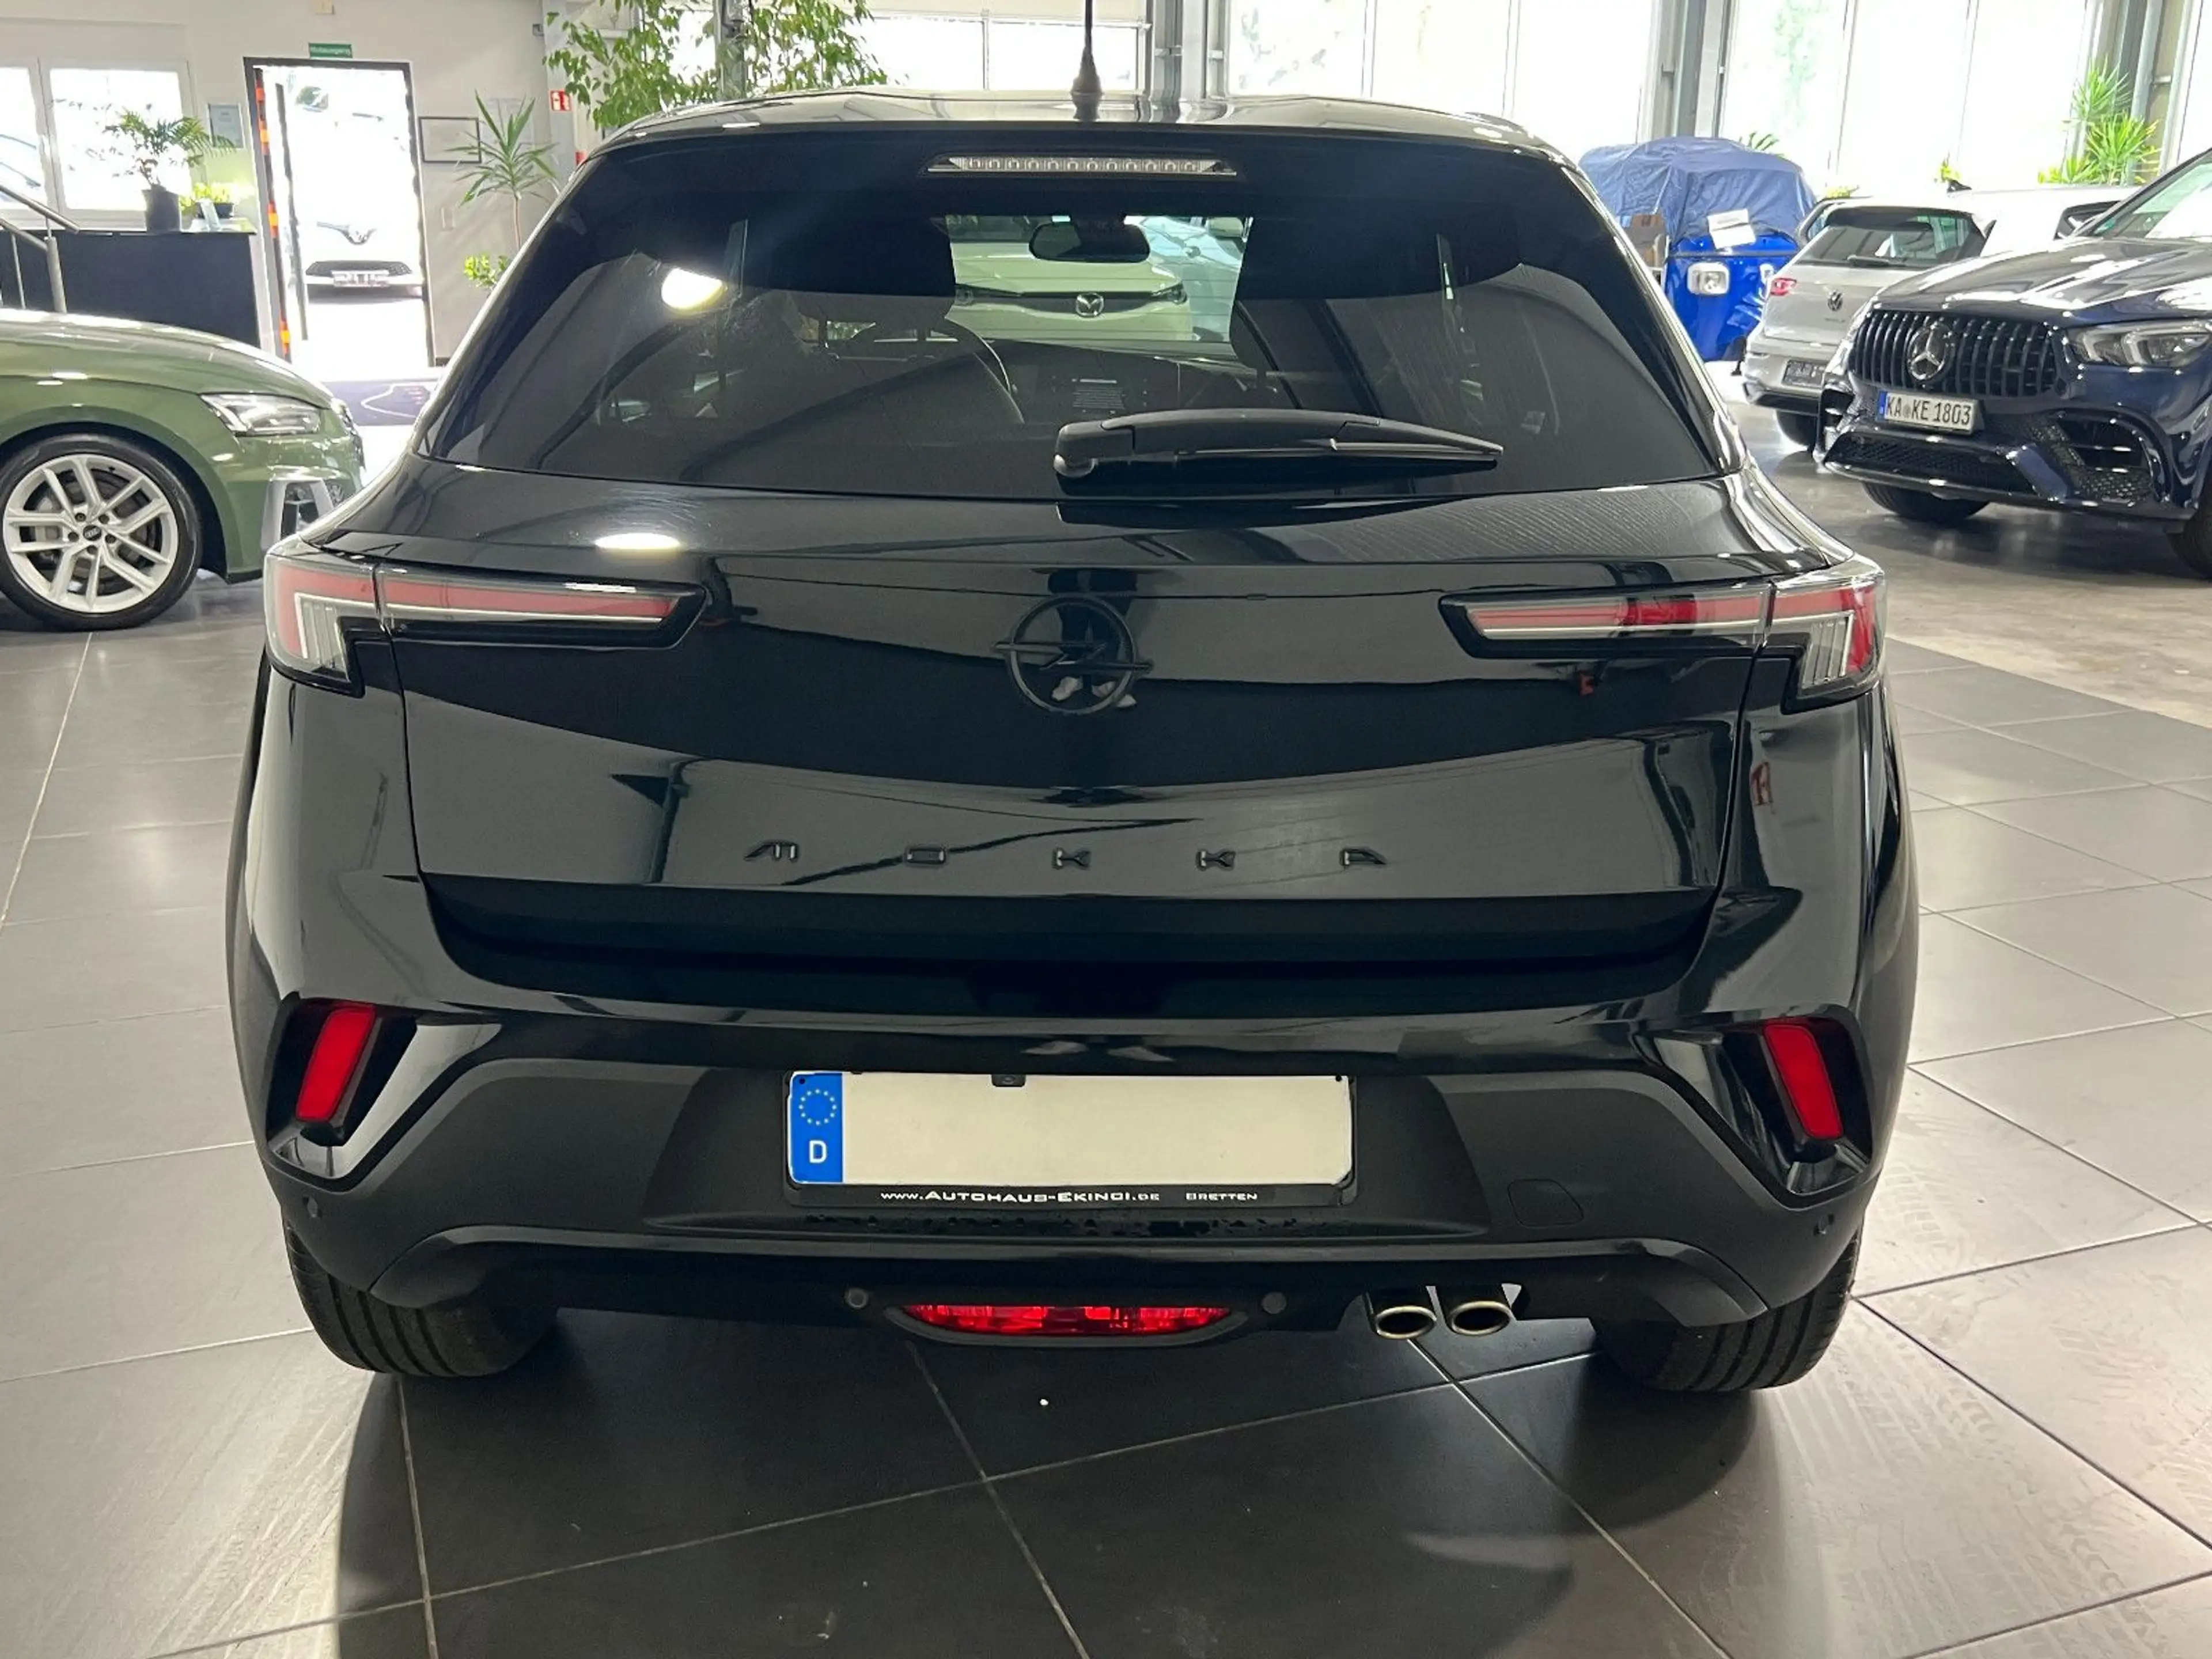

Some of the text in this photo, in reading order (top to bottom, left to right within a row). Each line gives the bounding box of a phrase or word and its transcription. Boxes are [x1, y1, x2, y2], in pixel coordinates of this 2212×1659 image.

[1887, 396, 1902, 418] KA
[1911, 399, 1930, 421] KE
[1932, 402, 1972, 425] 1803
[809, 1139, 827, 1164] D
